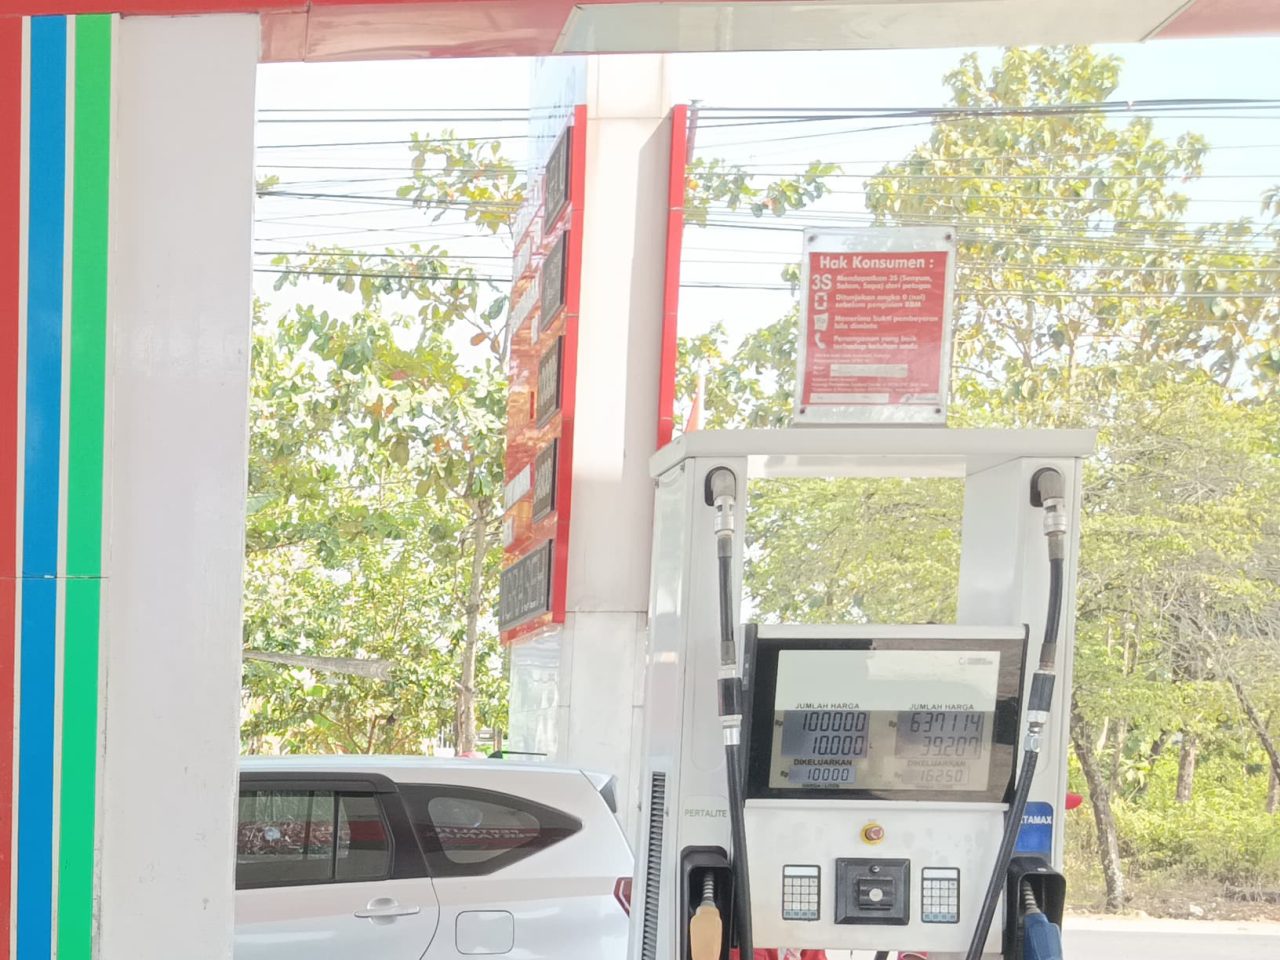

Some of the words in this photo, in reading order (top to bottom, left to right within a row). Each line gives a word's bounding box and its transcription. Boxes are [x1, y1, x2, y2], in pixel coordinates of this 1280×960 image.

[820, 256, 847, 269] Hak
[852, 255, 925, 269] Konsumen
[812, 274, 832, 290] 3S
[910, 703, 943, 711] JUMLAH
[944, 703, 975, 711] HARGA
[802, 711, 867, 732] 100000
[910, 712, 980, 733] 637114
[807, 768, 849, 781] 10000
[920, 769, 964, 783] 16250
[684, 809, 728, 818] PERTALITE
